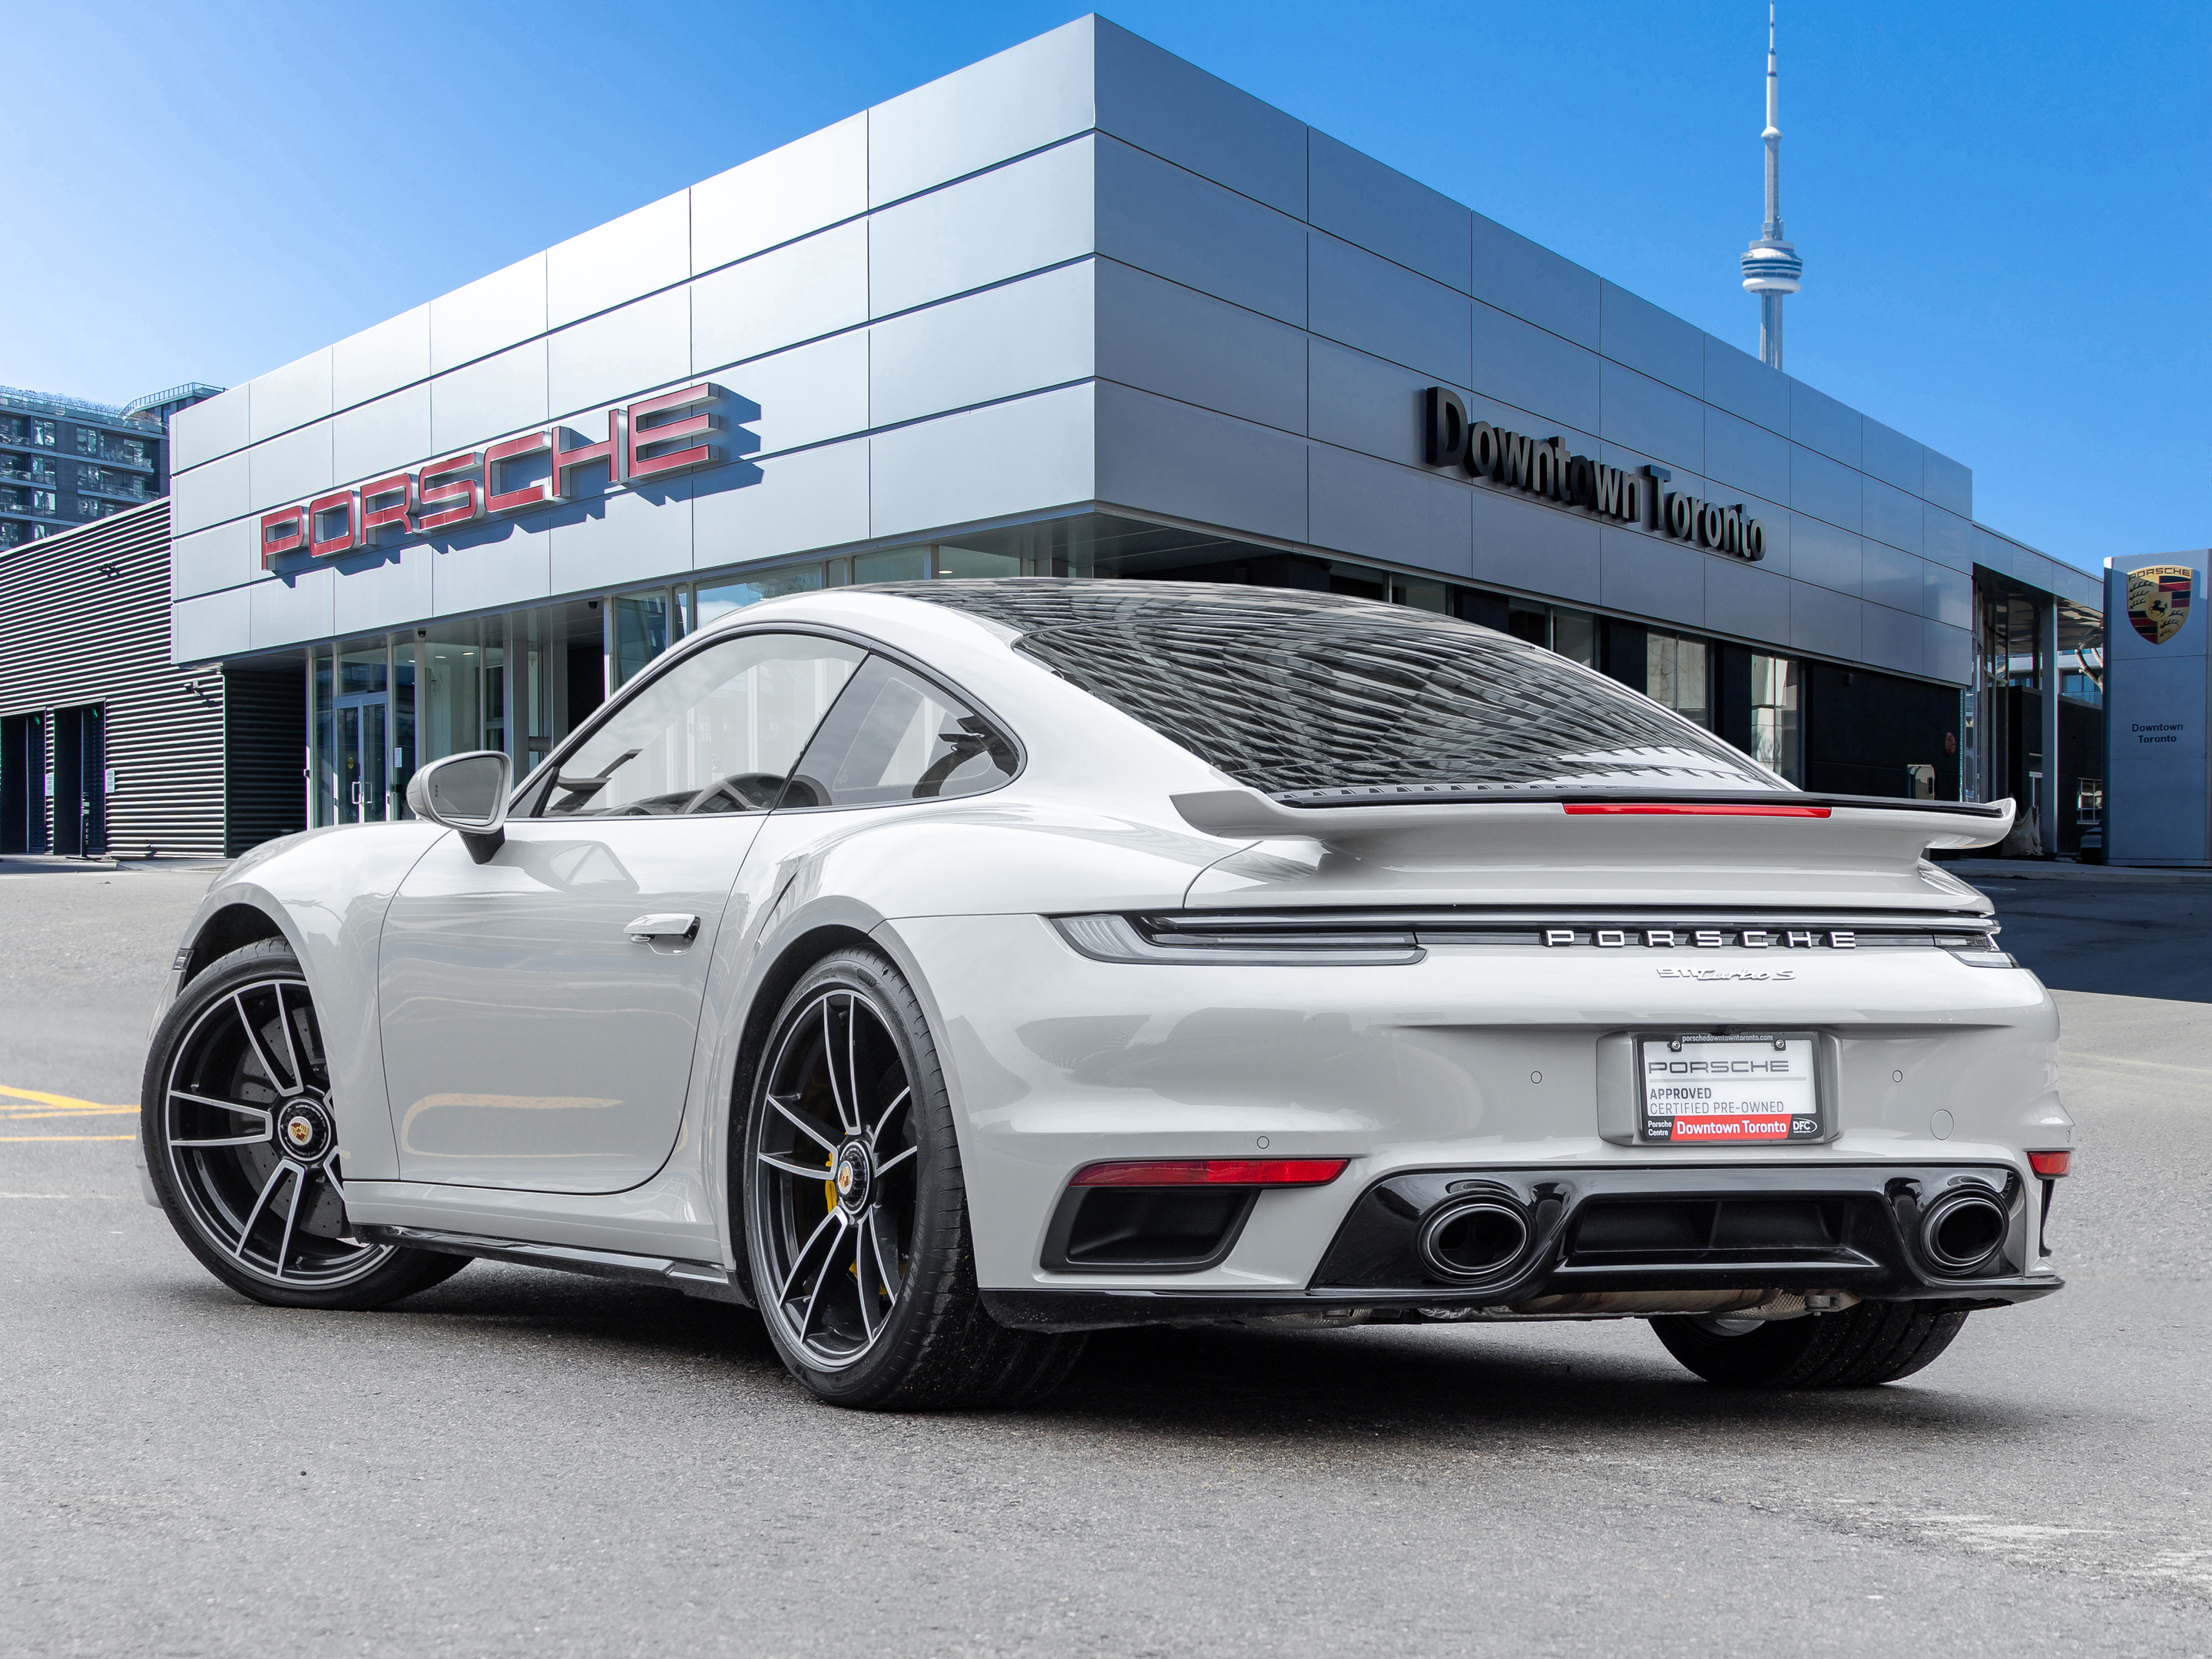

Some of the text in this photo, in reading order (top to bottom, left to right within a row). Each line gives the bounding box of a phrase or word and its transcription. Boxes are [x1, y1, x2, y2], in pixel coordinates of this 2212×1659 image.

[261, 382, 719, 571] PORSCHE
[1426, 386, 1767, 562] Downtown Toronto
[2128, 567, 2191, 582] PORSCHE
[2131, 724, 2184, 733] Downtown
[2137, 734, 2177, 743] Toronto
[1545, 929, 1856, 948] PORSCHE
[1682, 1034, 1773, 1043] porschedowntowntoronto.com
[1648, 1060, 1790, 1074] PORSCHE
[1650, 1087, 1712, 1100] APPROVED
[1650, 1101, 1784, 1114] CERTIFIED PRE-OWNED
[1647, 1120, 1673, 1128] Porsche
[1677, 1119, 1787, 1135] Downtown Toronto
[1793, 1121, 1811, 1131] DFC
[1648, 1128, 1669, 1137] Centre
